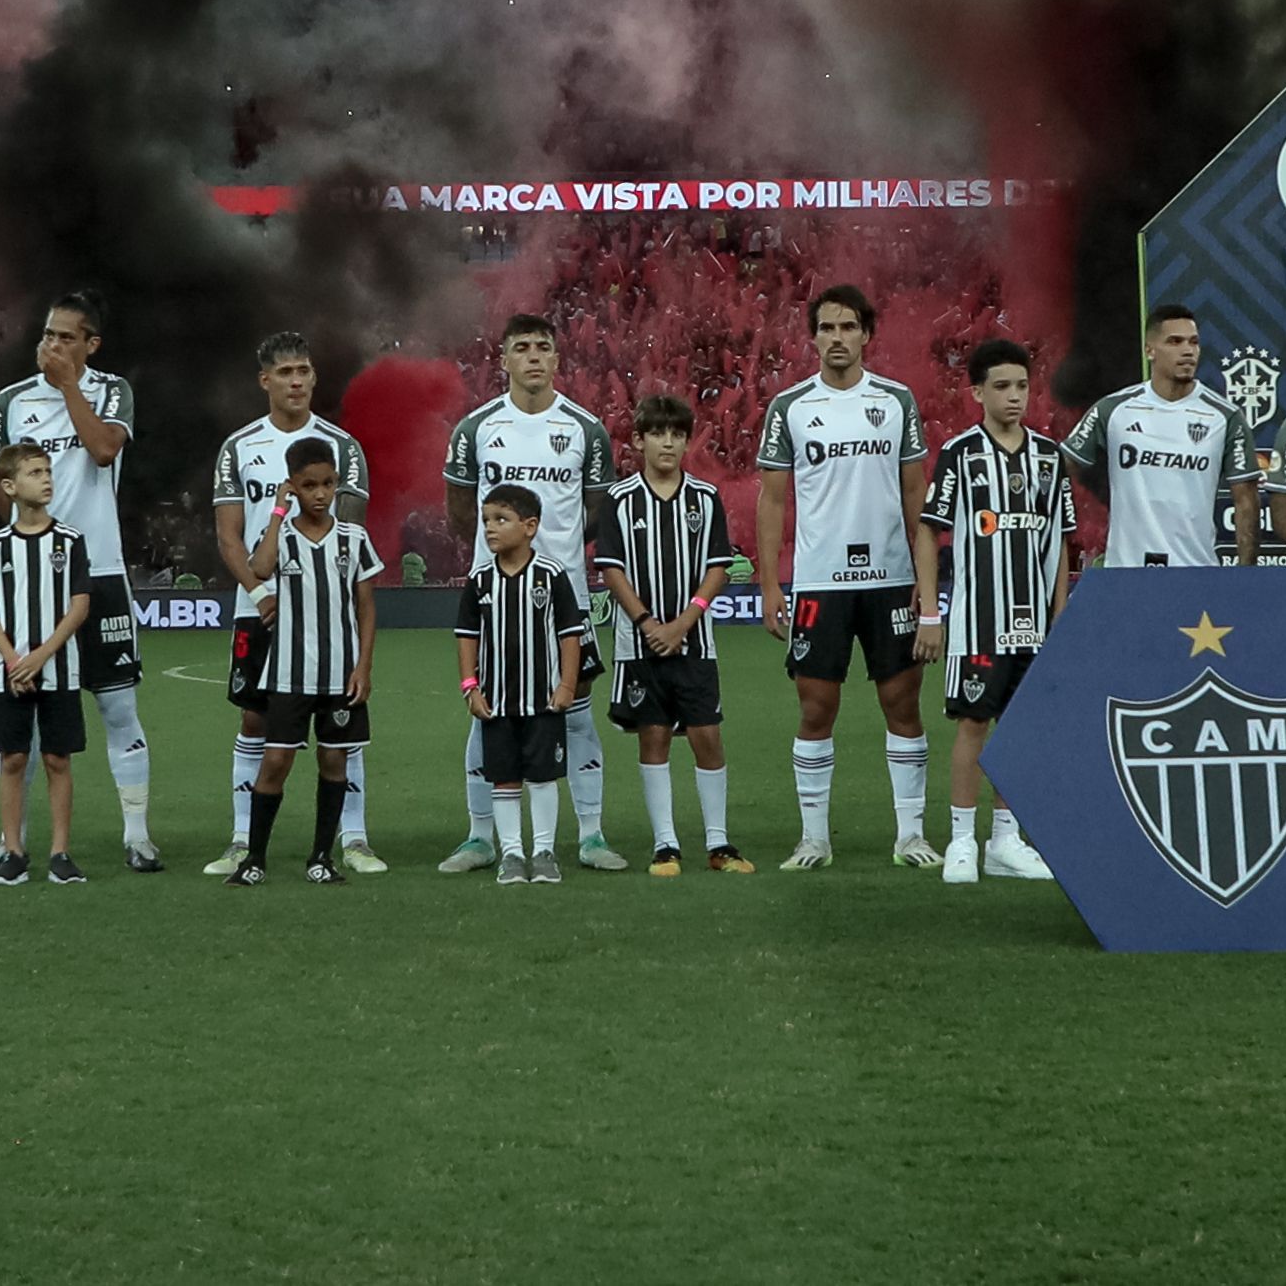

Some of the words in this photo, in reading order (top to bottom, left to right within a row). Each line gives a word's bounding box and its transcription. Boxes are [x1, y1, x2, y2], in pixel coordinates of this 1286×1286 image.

[420, 184, 566, 212] MARCA
[573, 182, 690, 211] VISTA
[699, 181, 782, 209] POR
[794, 179, 992, 208] MILHARES
[1082, 406, 1100, 439] MRV
[828, 440, 892, 458] BETANO
[1139, 450, 1209, 472] BETANO
[504, 466, 572, 483] BETANO
[943, 468, 957, 503] MRV
[832, 569, 887, 582] GERDAU
[100, 615, 130, 632] AUTO
[101, 628, 133, 644] TRUCK
